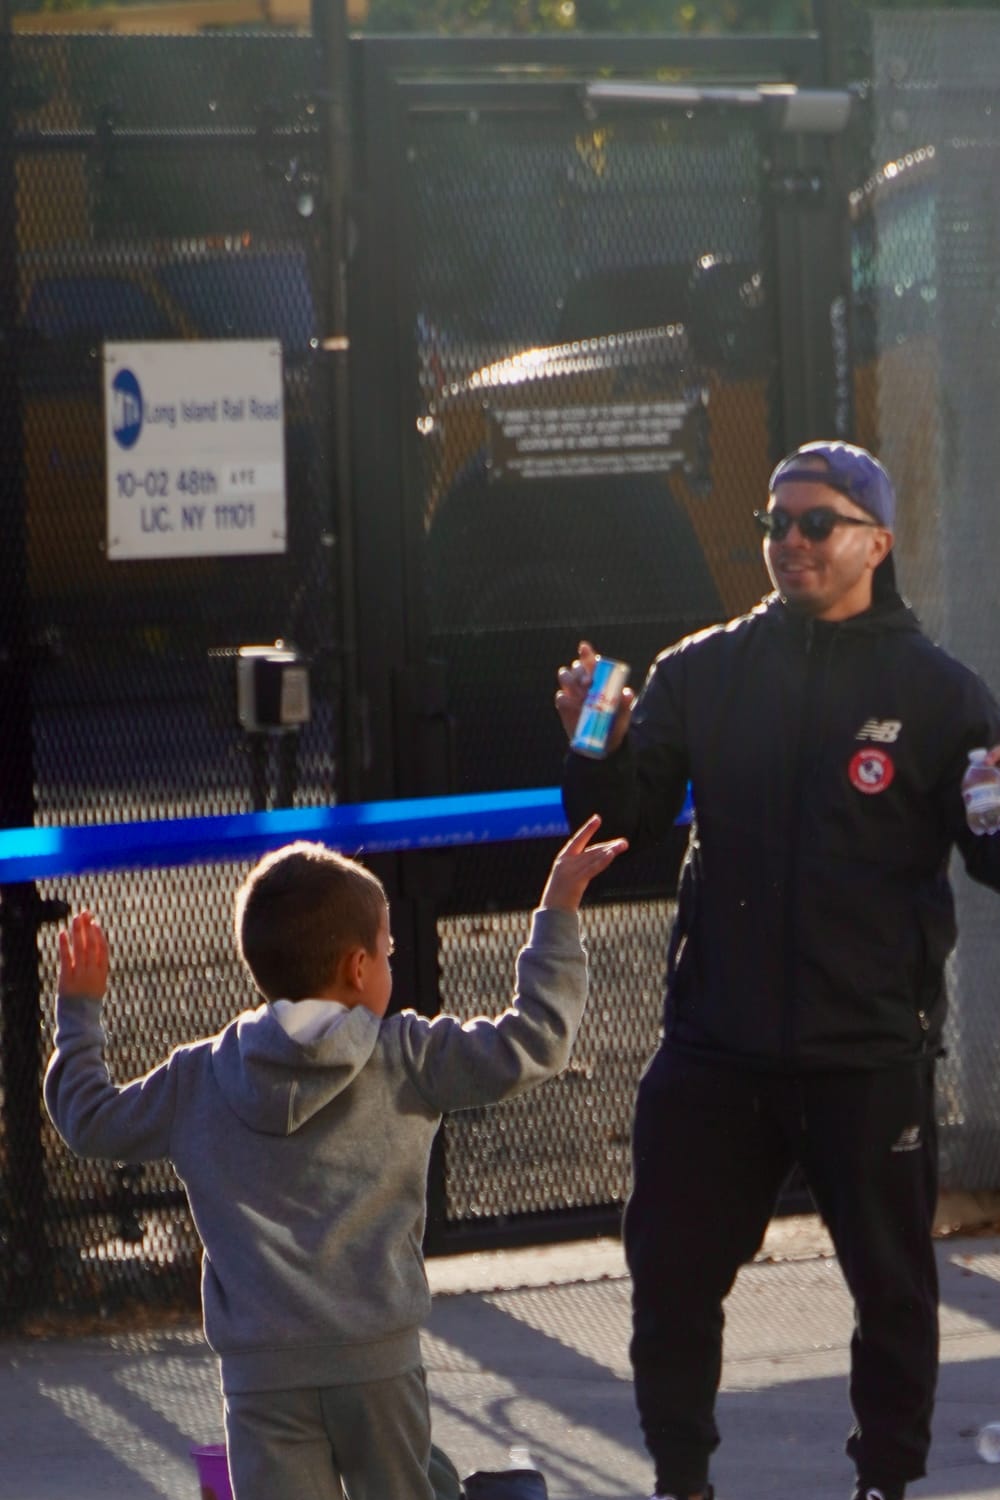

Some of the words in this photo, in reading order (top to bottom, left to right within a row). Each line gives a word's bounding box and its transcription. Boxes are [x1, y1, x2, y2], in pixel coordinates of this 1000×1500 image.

[144, 402, 177, 429] Long
[181, 399, 216, 423] Island
[222, 398, 243, 421] Rail
[248, 397, 281, 421] Road
[116, 469, 168, 498] 10-02
[176, 469, 217, 495] 48th
[181, 503, 206, 531] NY
[214, 502, 257, 530] 11101
